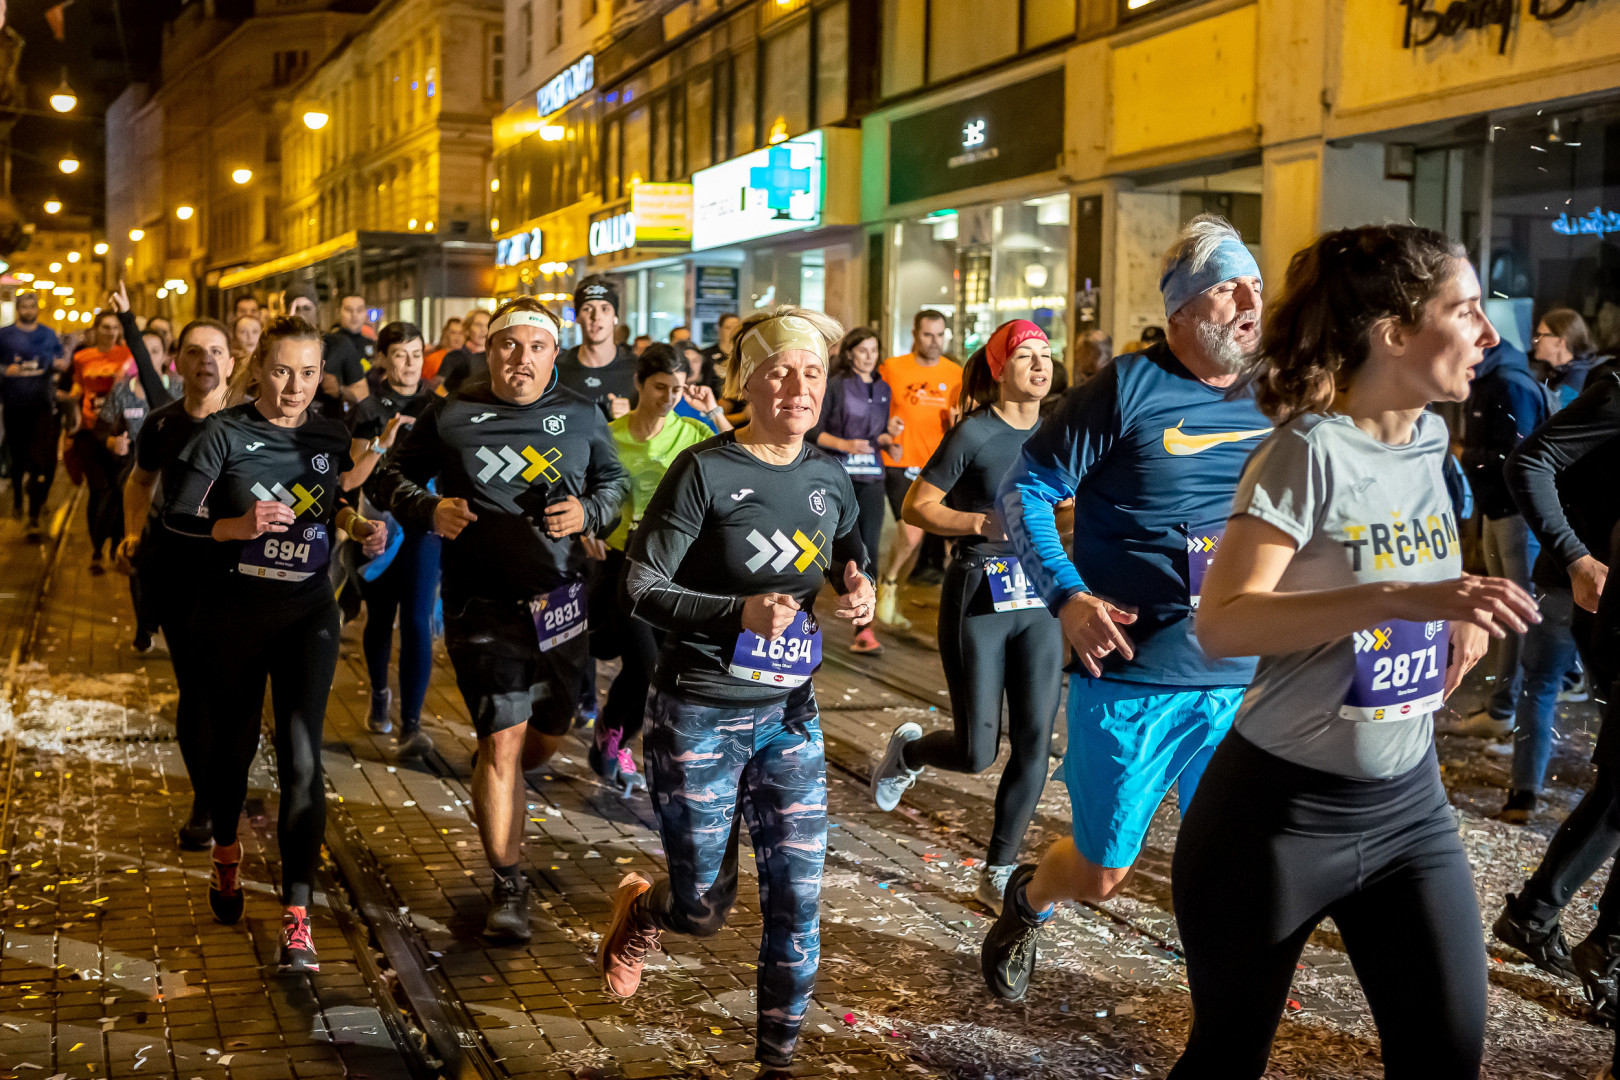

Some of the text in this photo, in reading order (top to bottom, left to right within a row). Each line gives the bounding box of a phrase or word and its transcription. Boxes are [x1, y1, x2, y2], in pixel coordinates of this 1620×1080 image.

[264, 538, 311, 563] 694
[1001, 573, 1033, 593] 14
[544, 598, 581, 631] 2831
[751, 635, 813, 664] 1634
[1371, 644, 1439, 691] 2871
